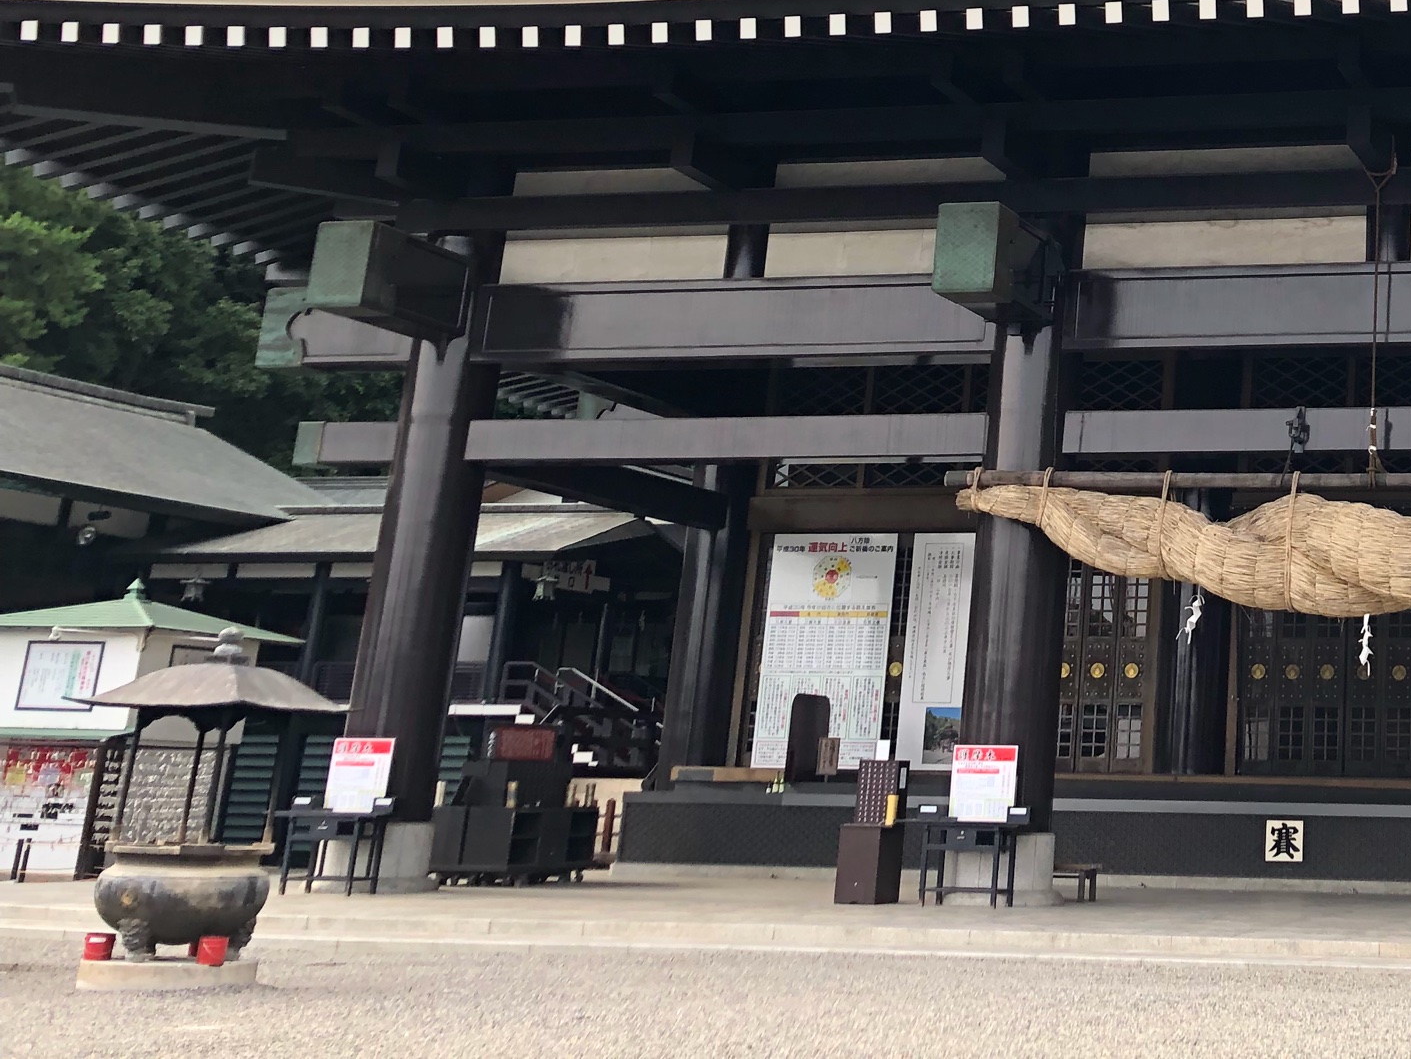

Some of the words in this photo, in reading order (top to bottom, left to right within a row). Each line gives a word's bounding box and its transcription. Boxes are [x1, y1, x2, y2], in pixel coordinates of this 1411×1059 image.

[807, 542, 848, 553] 運気向上
[1269, 822, 1300, 859] 賽
